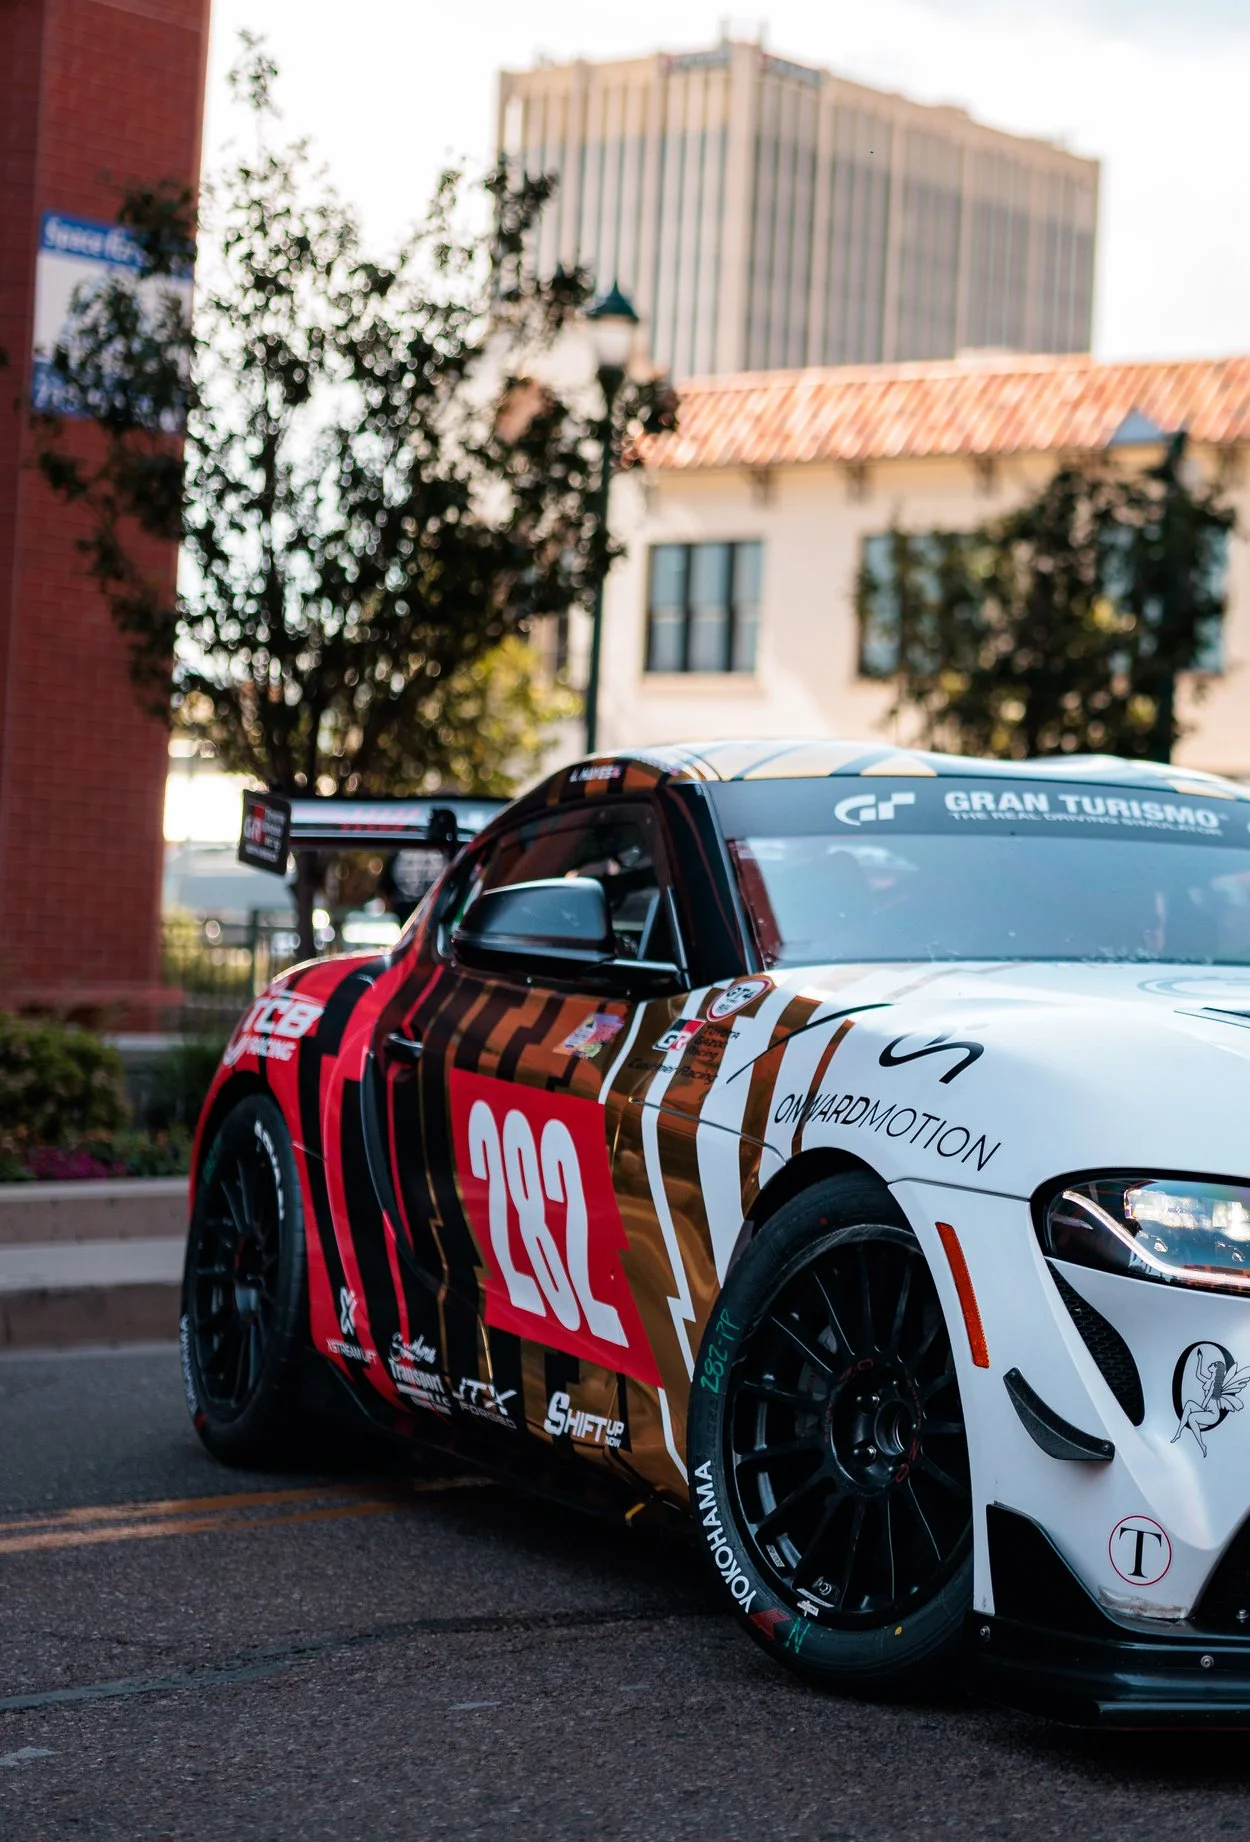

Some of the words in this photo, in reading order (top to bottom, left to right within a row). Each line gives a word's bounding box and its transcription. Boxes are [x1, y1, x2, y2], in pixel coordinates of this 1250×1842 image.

[944, 791, 1050, 813] GRAN
[1057, 793, 1221, 829] TURISMO
[952, 812, 989, 821] THE
[991, 812, 1037, 822] REAL
[1043, 813, 1120, 826] DRIVING
[1121, 818, 1224, 837] SIMULATOR
[468, 1099, 630, 1349] 282
[605, 1418, 626, 1438] UP
[694, 1459, 757, 1615] YOKOHAMA
[1118, 1526, 1162, 1579] T
